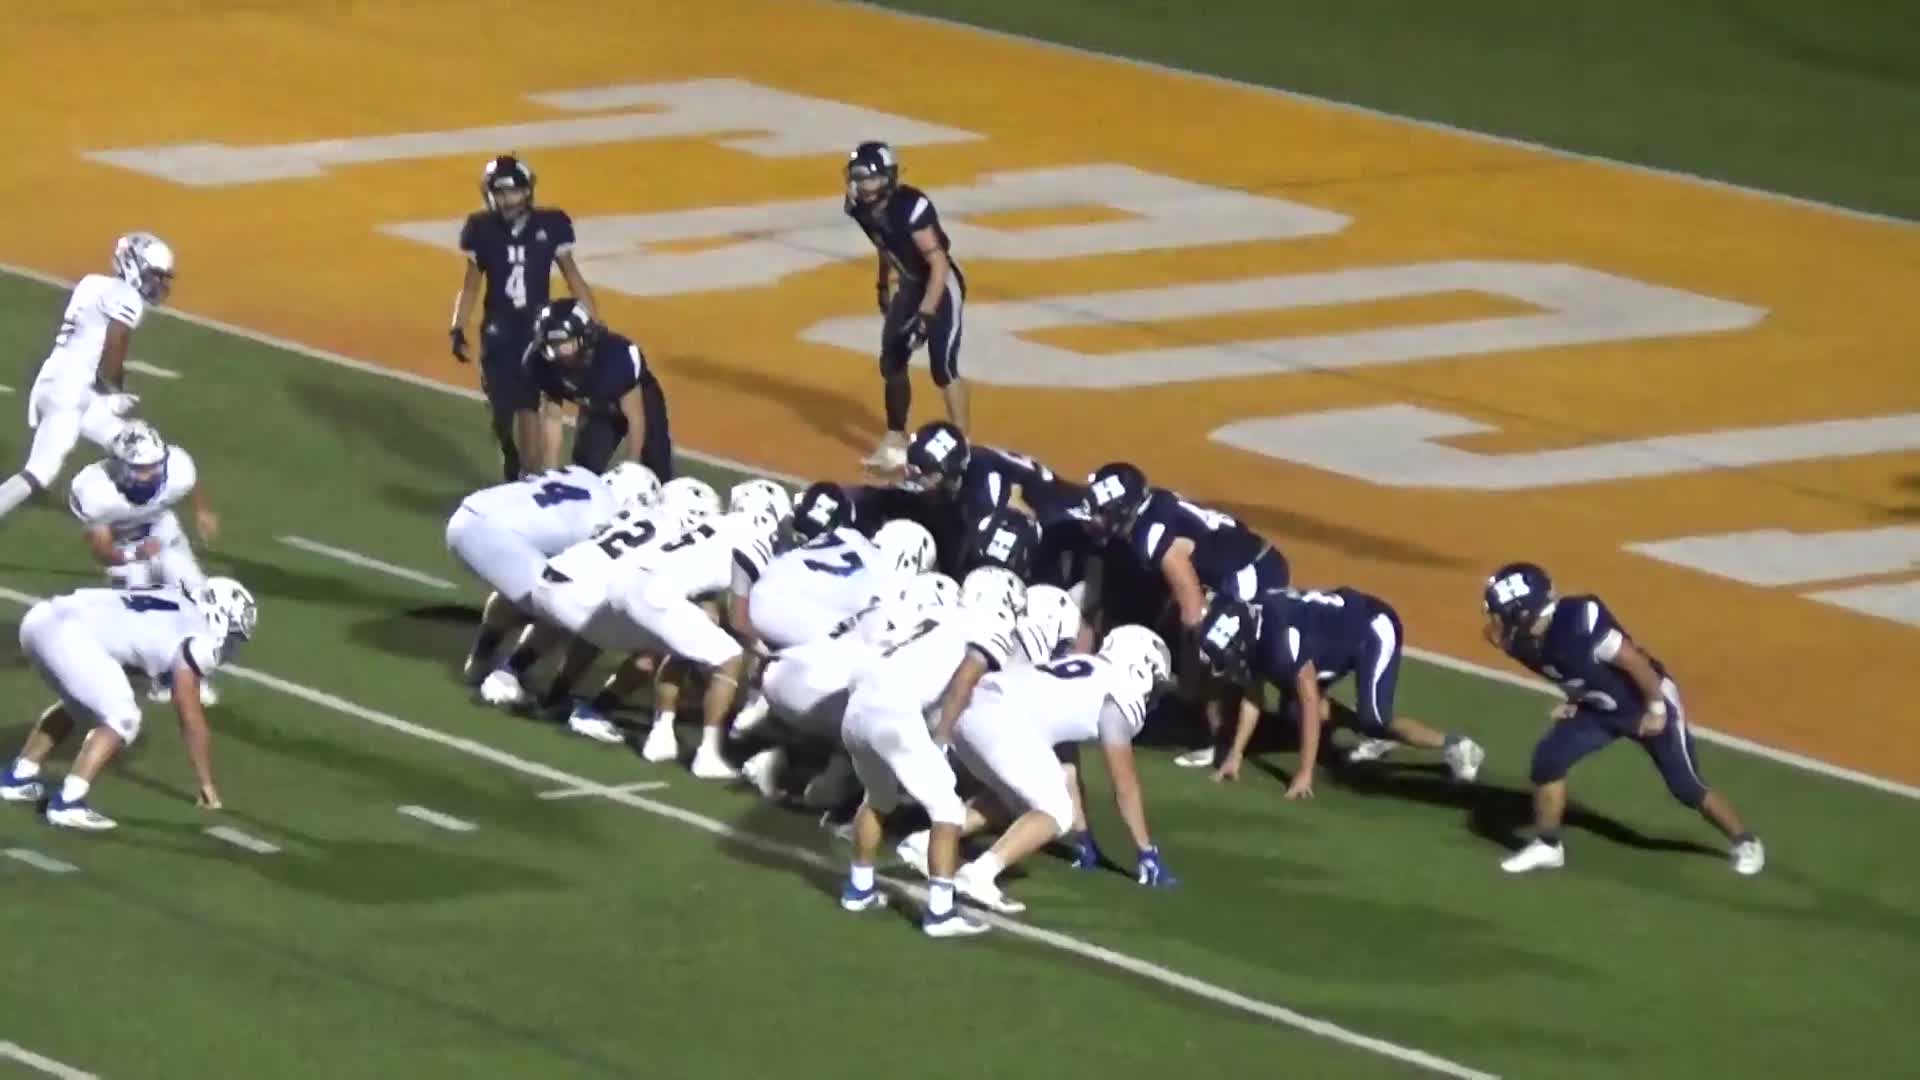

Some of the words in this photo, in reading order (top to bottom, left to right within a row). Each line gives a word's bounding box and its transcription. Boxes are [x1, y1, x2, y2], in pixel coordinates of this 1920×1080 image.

[504, 264, 528, 309] 4
[80, 76, 1920, 630] TROJ
[924, 428, 958, 463] H
[1091, 474, 1126, 506] H
[985, 527, 1017, 562] H
[1493, 572, 1531, 604] H
[1206, 612, 1241, 650] H
